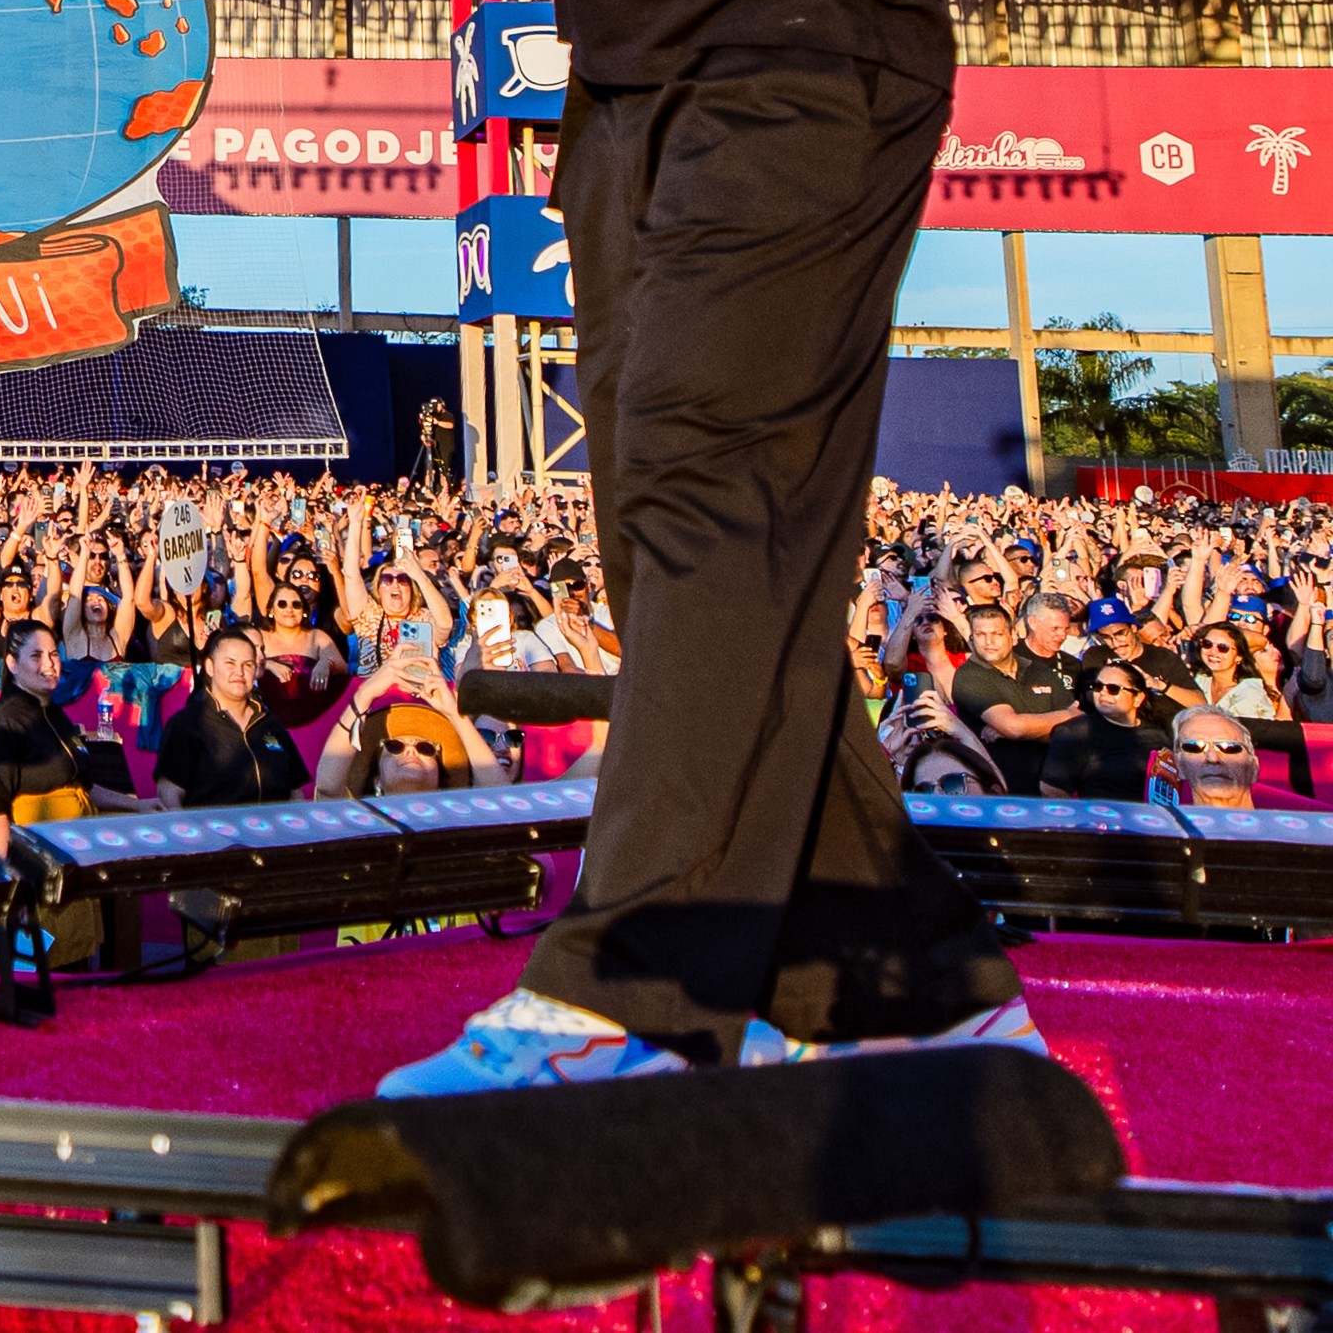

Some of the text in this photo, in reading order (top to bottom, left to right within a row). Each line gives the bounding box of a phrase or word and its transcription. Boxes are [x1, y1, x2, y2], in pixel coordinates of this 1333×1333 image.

[1151, 144, 1183, 169] CB
[1265, 448, 1333, 475] ITAIPAV
[174, 504, 191, 526] 246
[164, 529, 204, 561] GARÇOM
